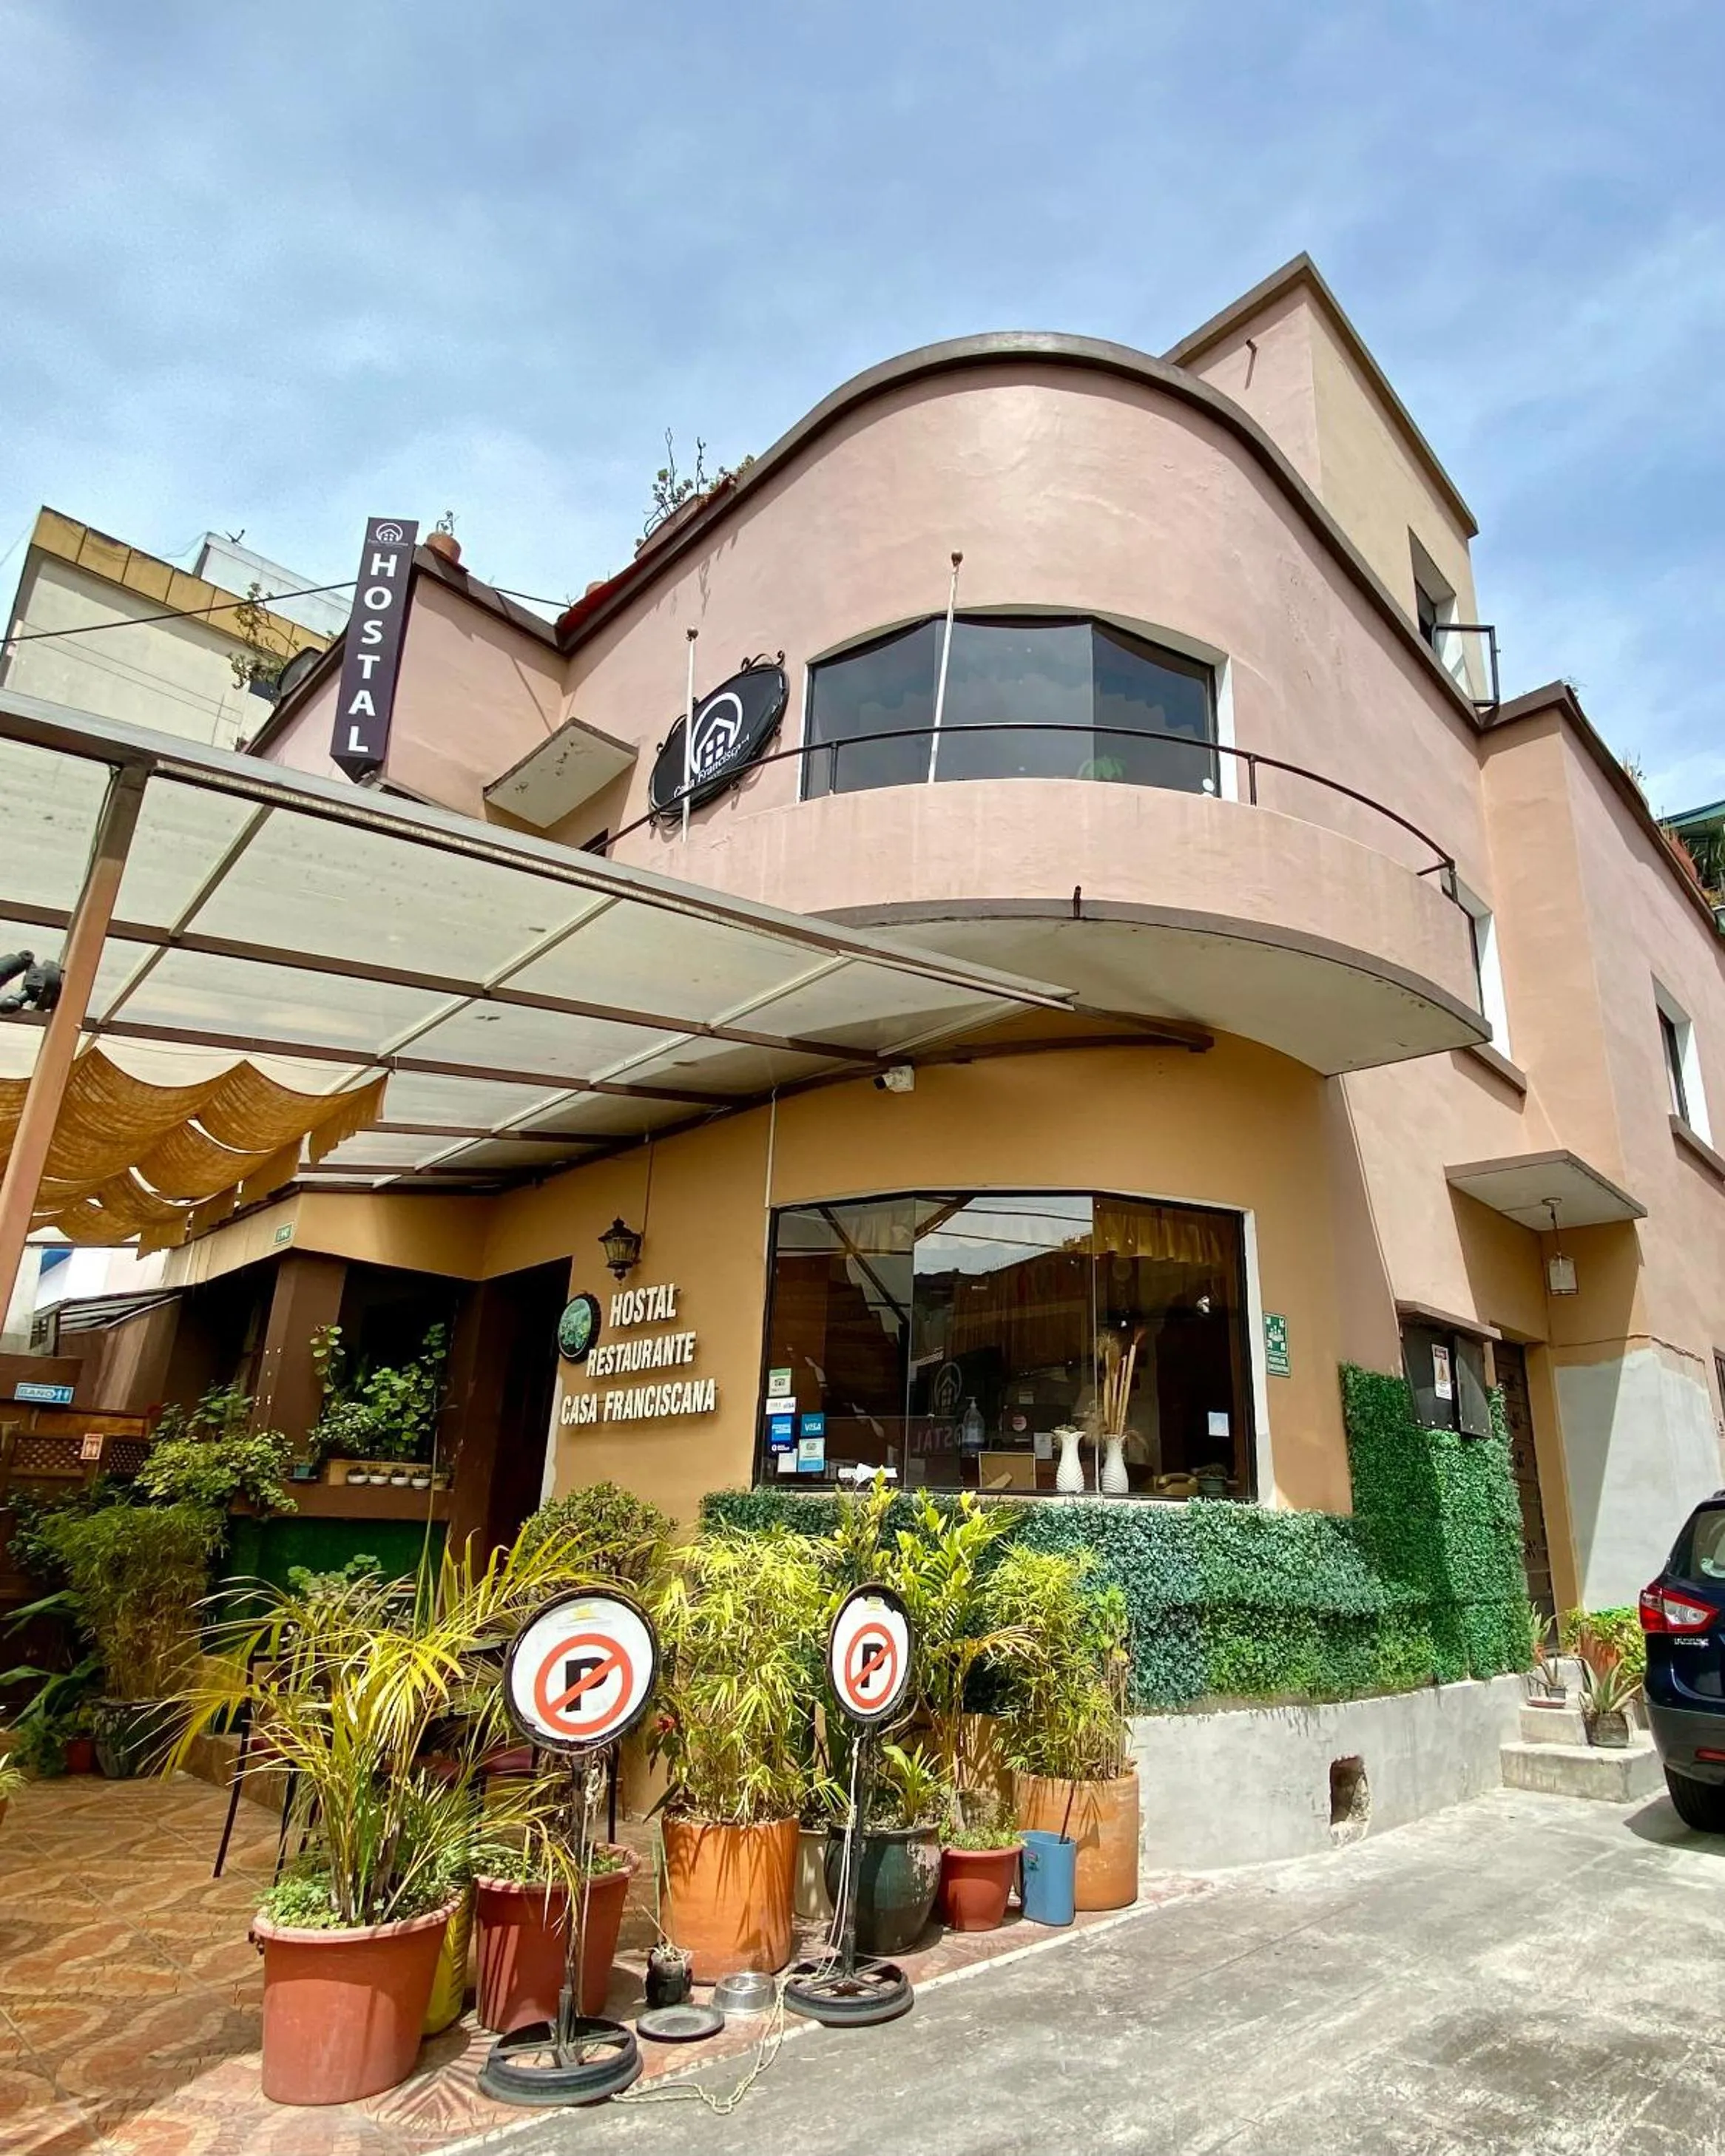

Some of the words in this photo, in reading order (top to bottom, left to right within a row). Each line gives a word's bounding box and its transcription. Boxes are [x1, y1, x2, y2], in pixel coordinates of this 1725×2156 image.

[348, 552, 397, 753] HOSTAL
[609, 1283, 677, 1328] HOSTAL
[586, 1331, 697, 1378] RESTAURANTE
[561, 1393, 598, 1425] CASA
[603, 1378, 716, 1422] FRANCISCANA
[804, 1422, 822, 1432] VISA
[564, 1656, 610, 1712] P
[861, 1642, 884, 1689] P
